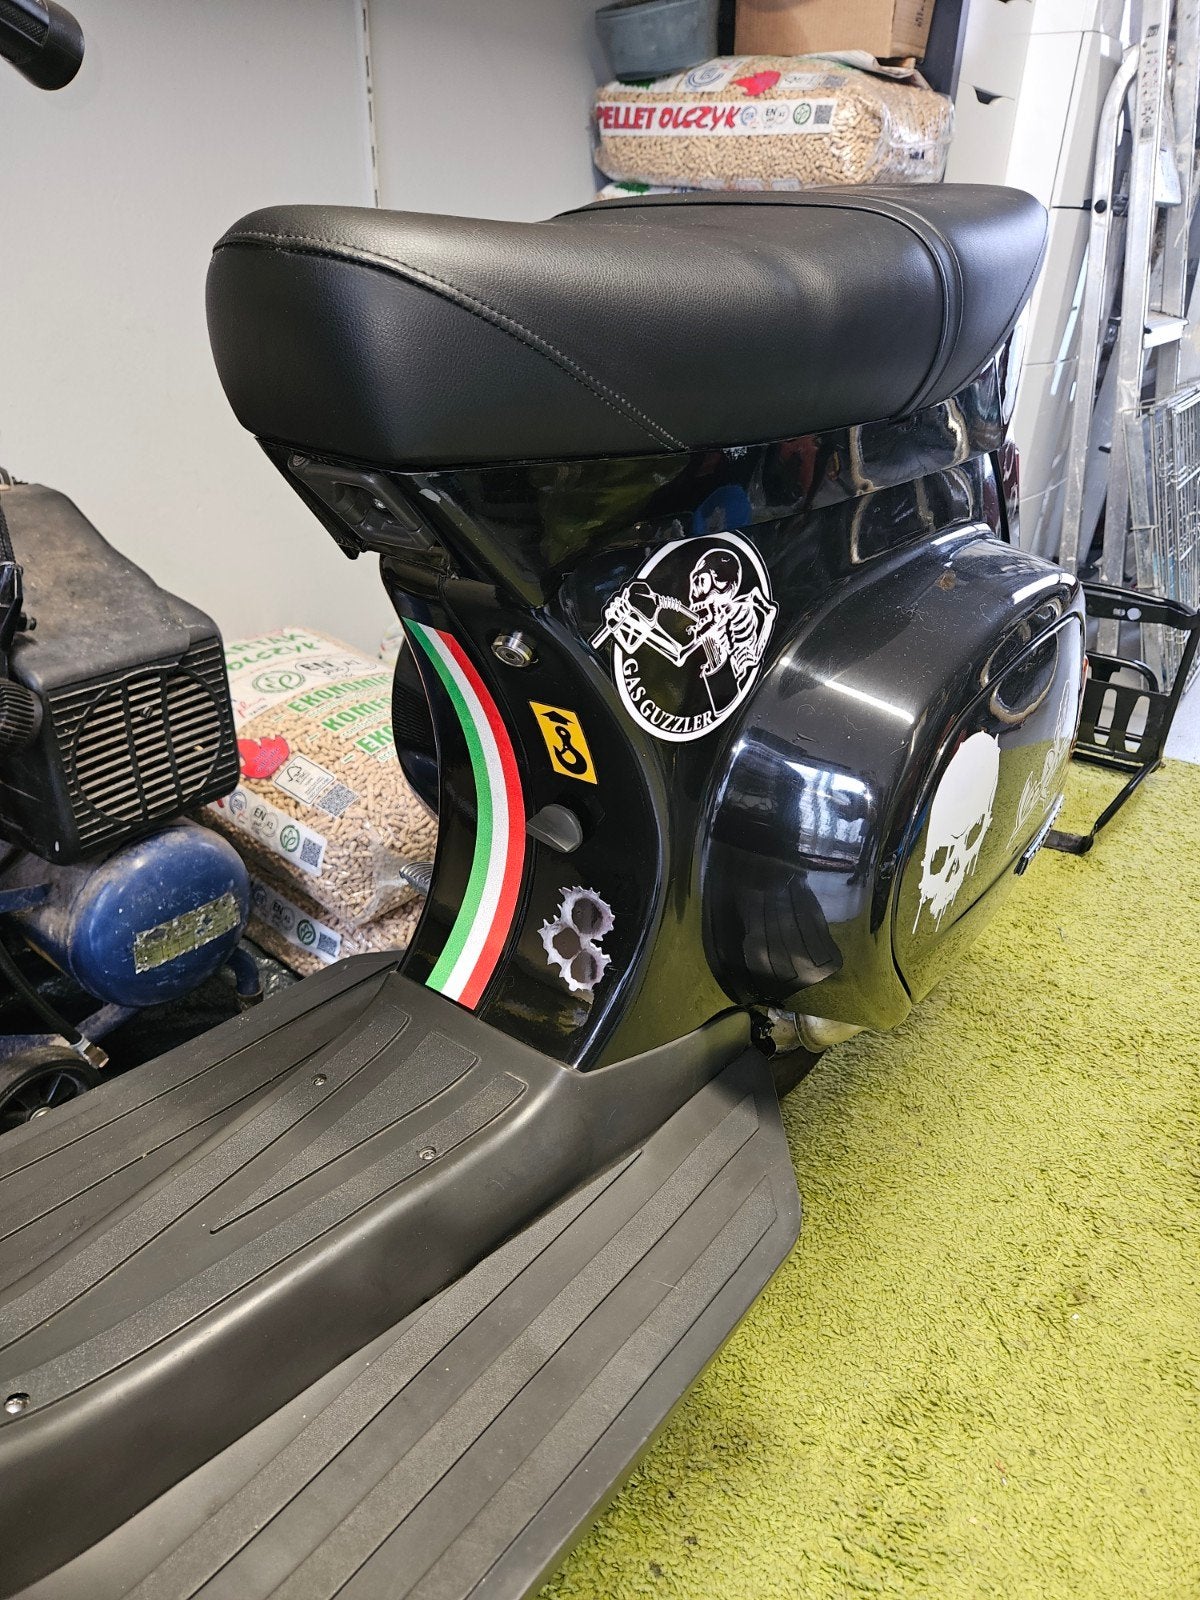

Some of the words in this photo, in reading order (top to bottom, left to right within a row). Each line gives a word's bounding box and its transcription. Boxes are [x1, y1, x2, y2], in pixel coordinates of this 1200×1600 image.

[596, 106, 656, 129] PELLET
[658, 105, 741, 131] OLCZYK
[623, 658, 646, 702] GAS
[640, 699, 713, 733] GUZZLER
